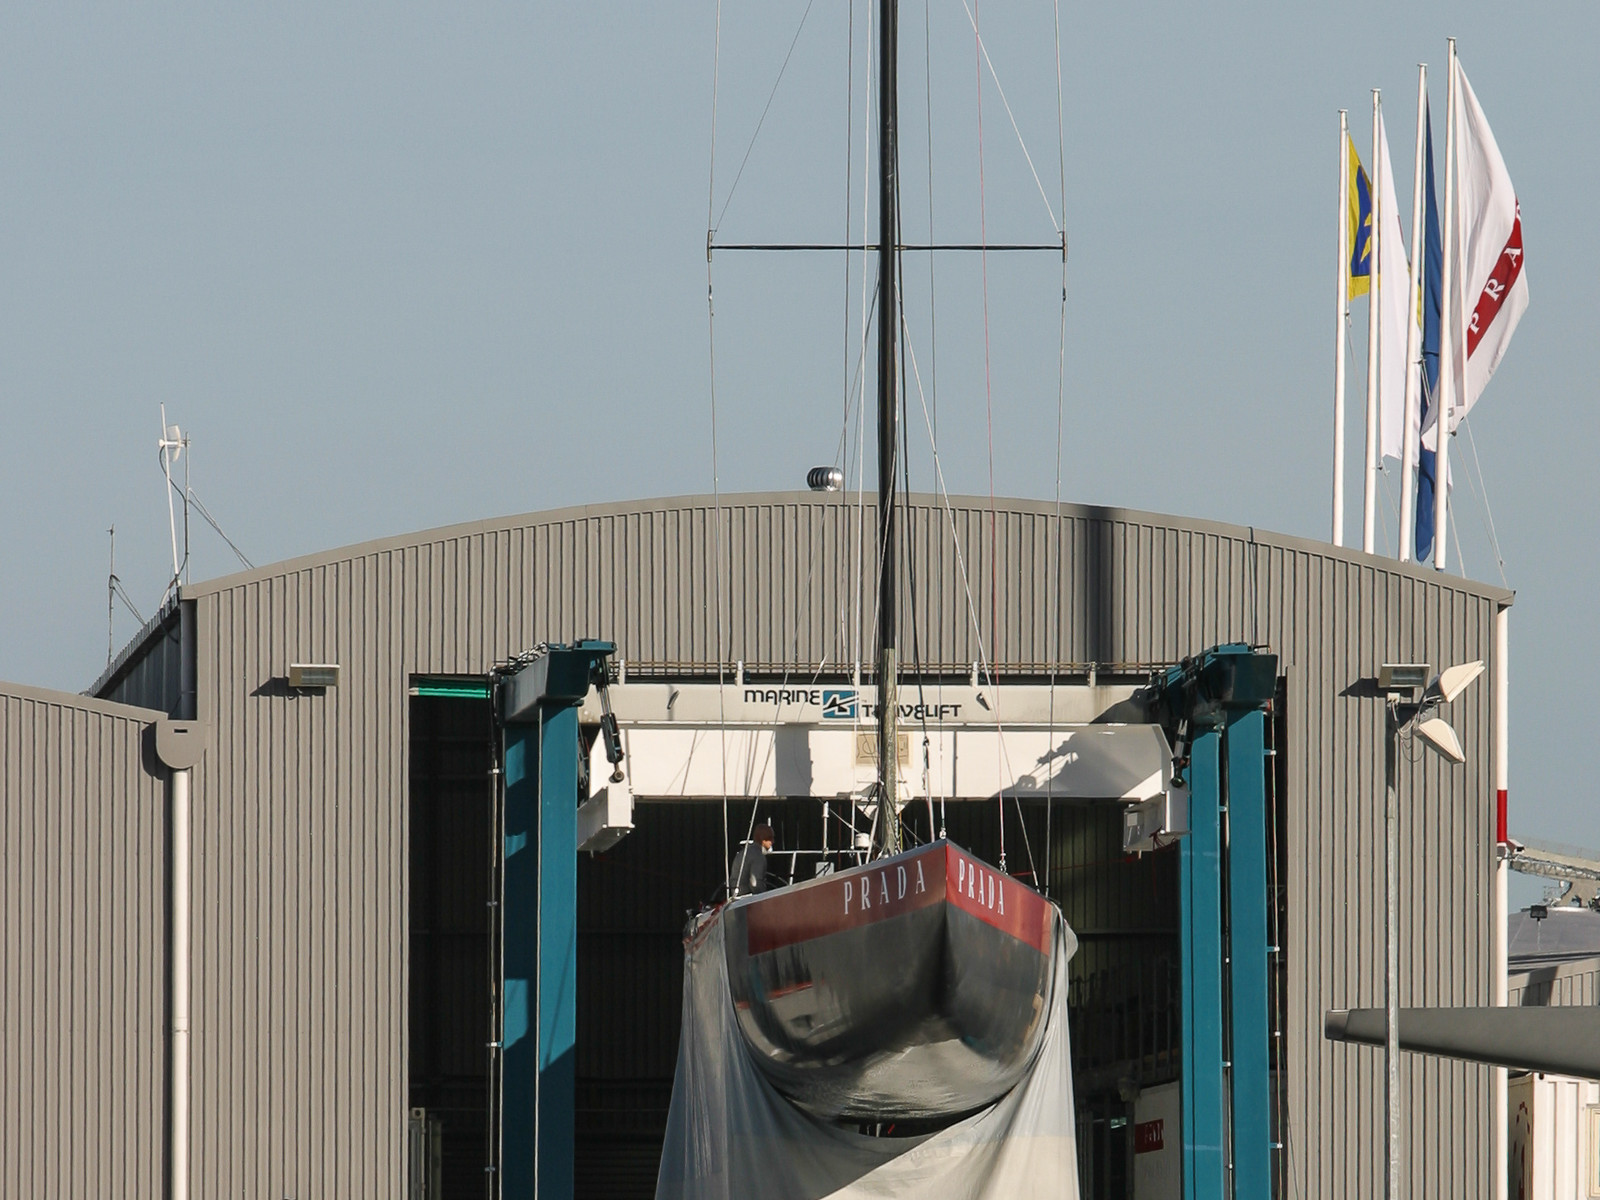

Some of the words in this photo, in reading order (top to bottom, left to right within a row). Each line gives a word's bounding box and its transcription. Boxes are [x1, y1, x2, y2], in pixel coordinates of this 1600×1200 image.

[744, 690, 820, 705] MARINE
[844, 860, 926, 915] PRADA
[958, 858, 1005, 916] PRADA
